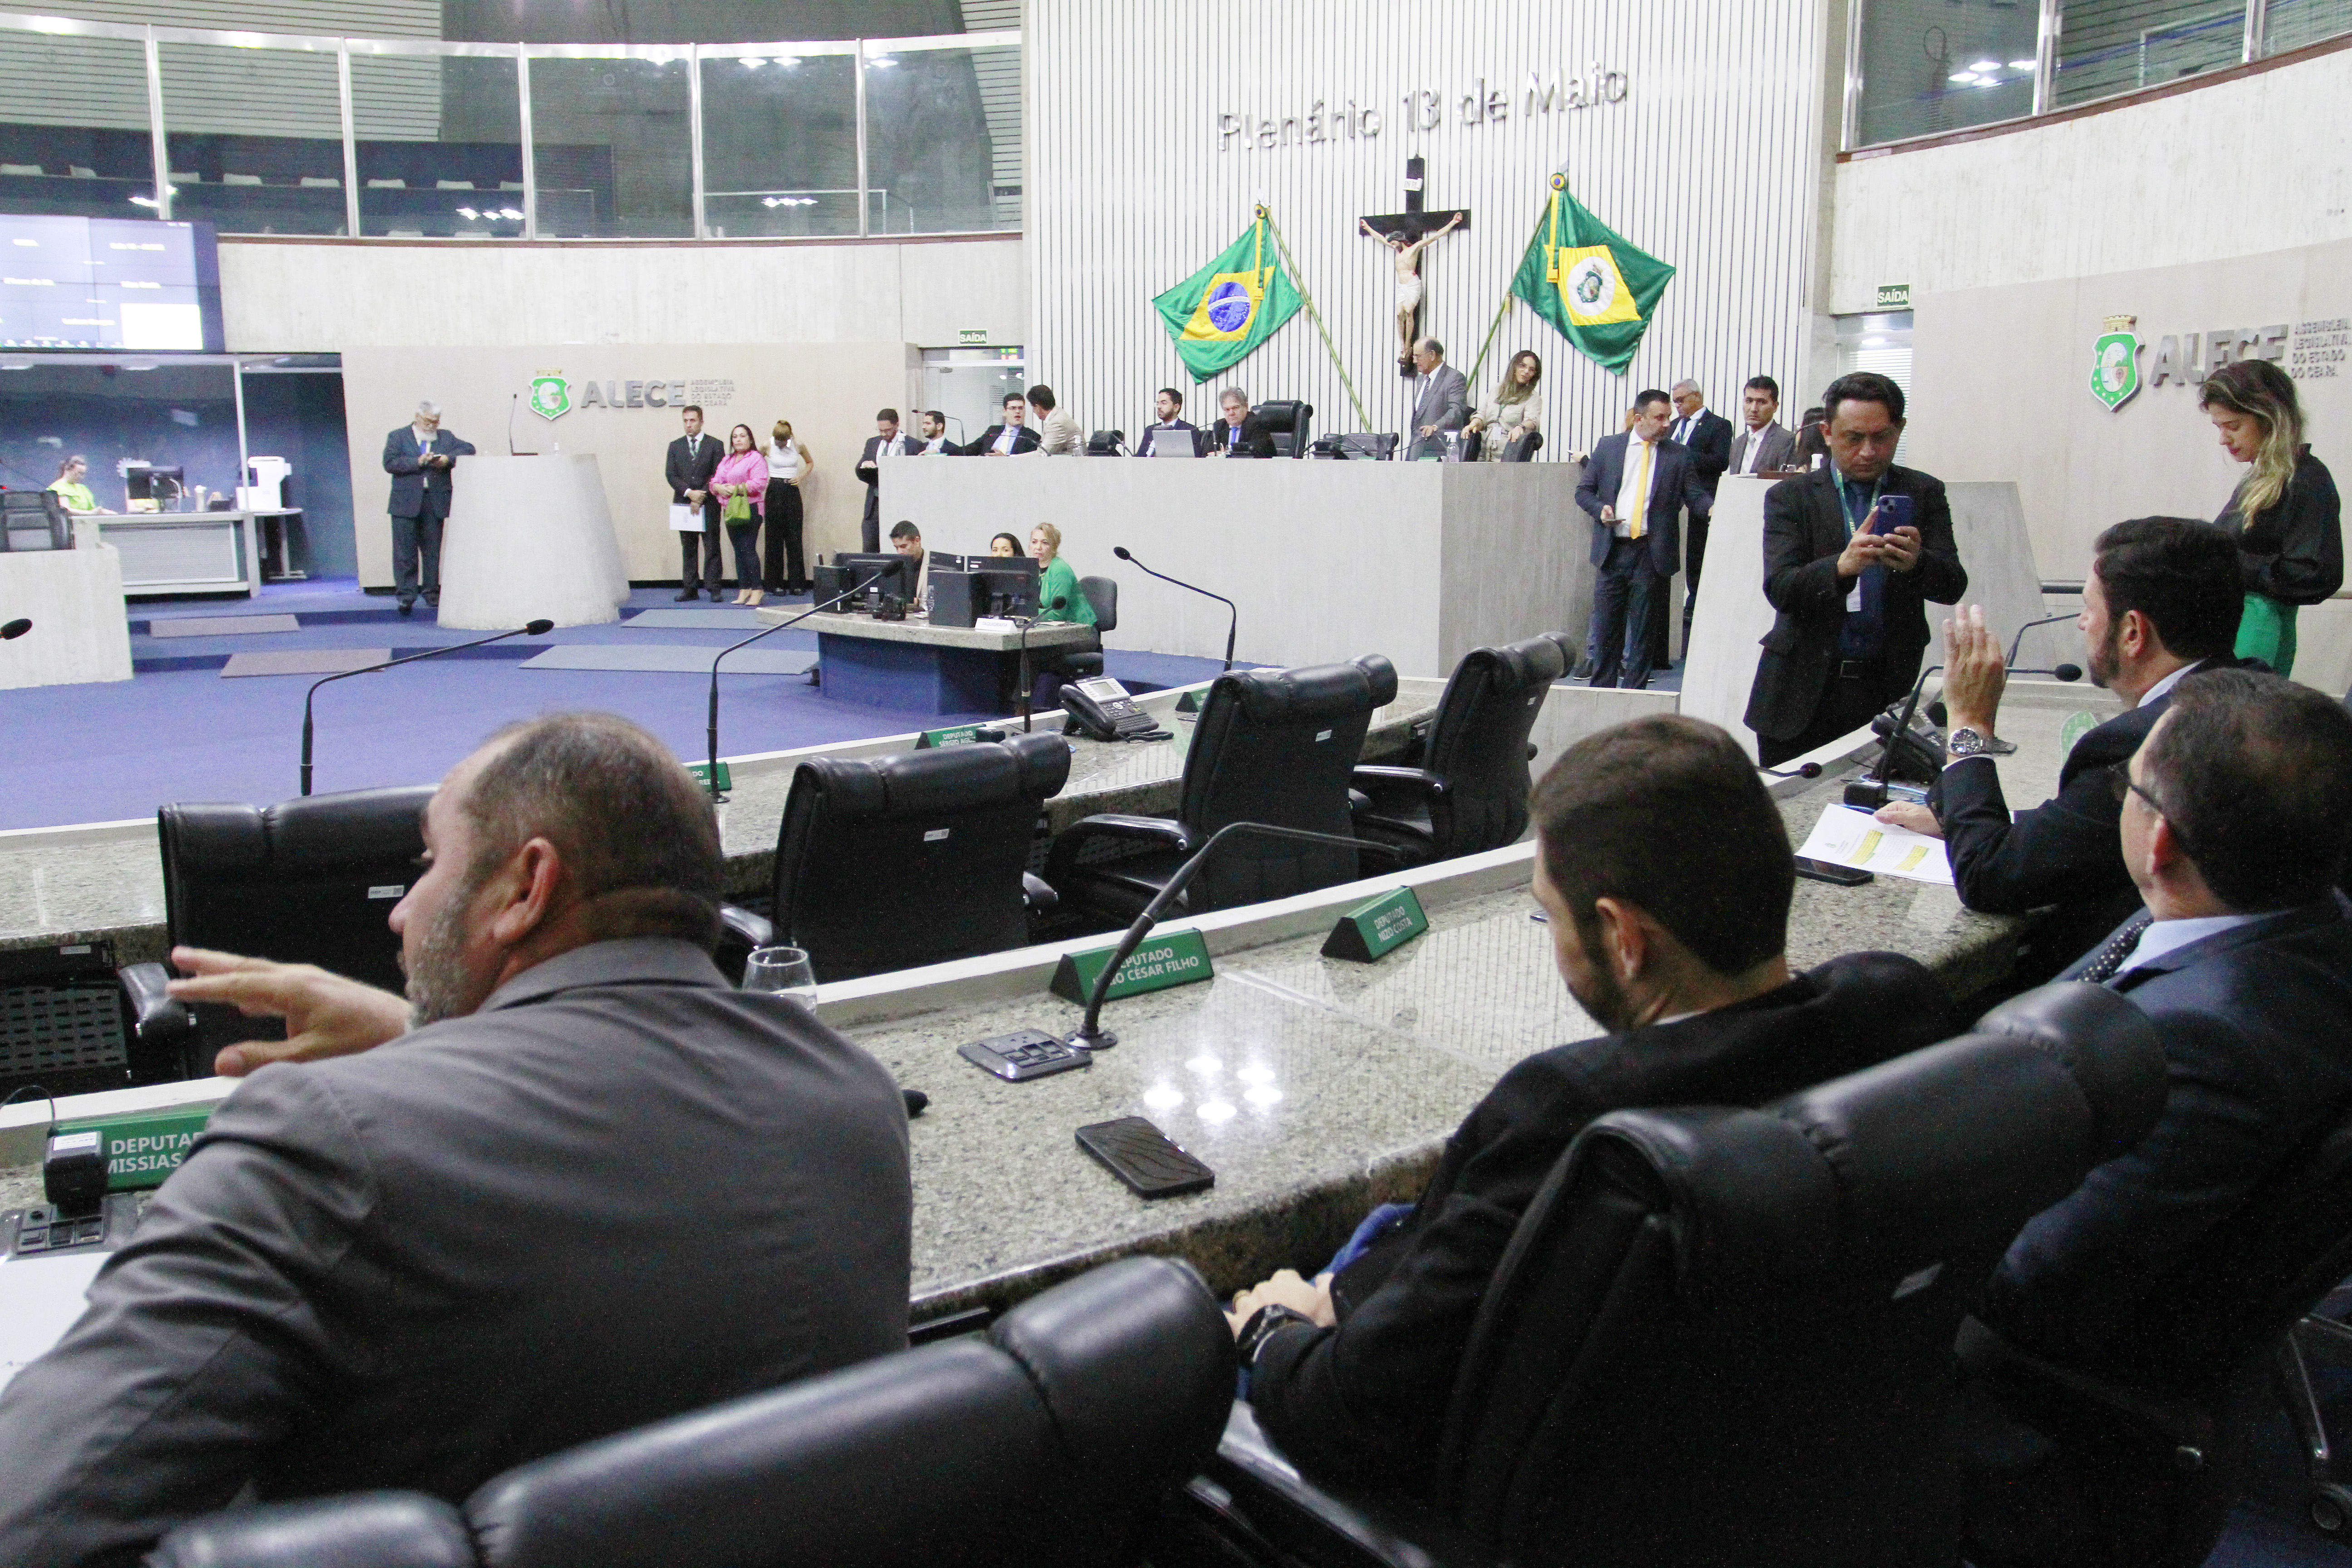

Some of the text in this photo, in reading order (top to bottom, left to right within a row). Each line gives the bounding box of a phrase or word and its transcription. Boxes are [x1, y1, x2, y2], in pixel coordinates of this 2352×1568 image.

[1218, 61, 1628, 151] Plenário 13 de Maio
[1877, 288, 1908, 304] SAÍDA
[960, 332, 987, 343] SAÍDA
[581, 379, 686, 408] ALECE
[942, 730, 973, 740] DEPUTADO
[1374, 906, 1406, 930] DEPUTADO
[1393, 917, 1413, 934] COSTA
[1121, 948, 1174, 968] PUTADO
[1127, 964, 1165, 981] CÉSAR
[1165, 956, 1199, 973] FILHO
[111, 1132, 204, 1155] DEPUTA
